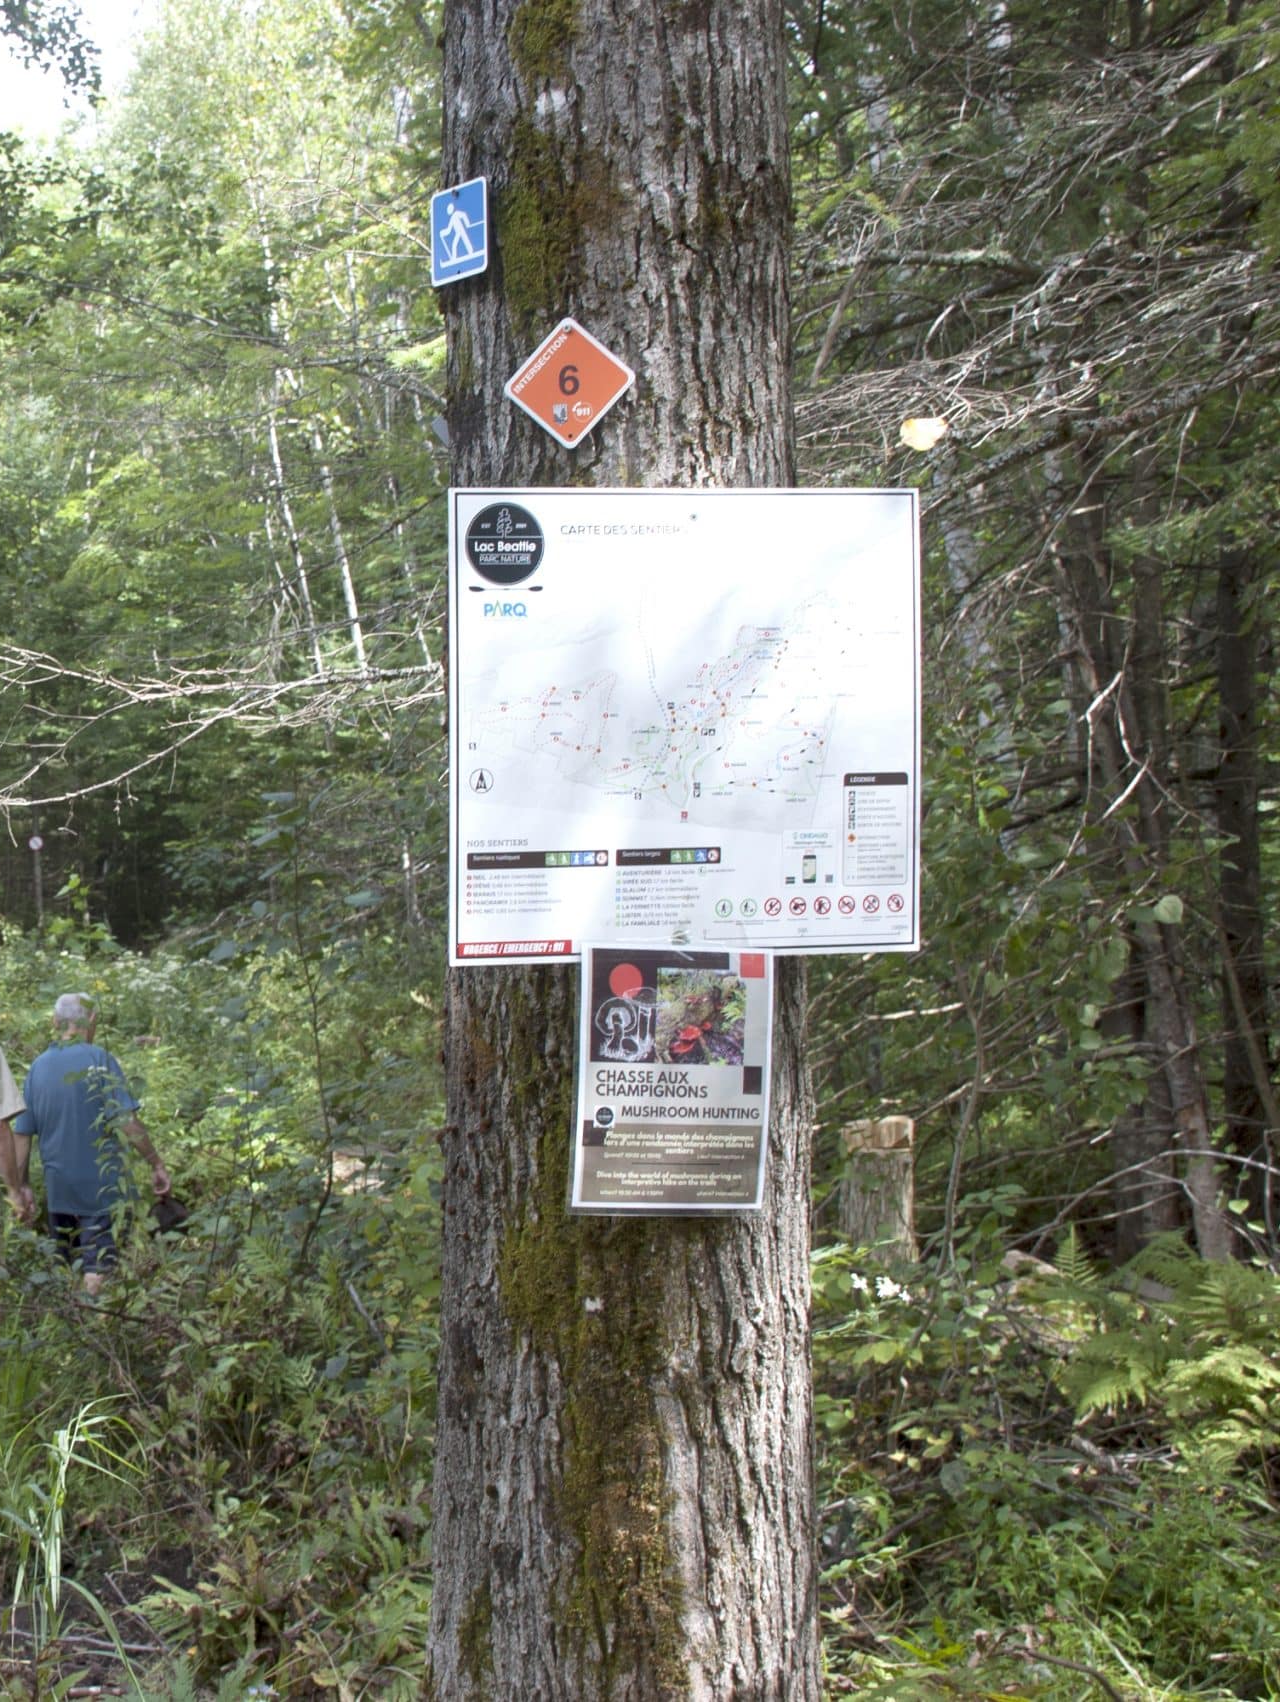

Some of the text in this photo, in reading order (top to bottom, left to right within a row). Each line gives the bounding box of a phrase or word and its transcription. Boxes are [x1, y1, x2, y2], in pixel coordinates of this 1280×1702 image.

[513, 333, 568, 394] INTERSECTION
[558, 364, 580, 396] 6
[575, 407, 591, 417] 911
[560, 525, 601, 535] CARTE
[604, 525, 627, 535] DES
[474, 540, 537, 552] Lac Beattie
[484, 600, 528, 617] PARQ
[467, 838, 529, 848] NOS SENTIERS
[596, 1069, 689, 1084] CHASSE AUX
[595, 1083, 708, 1098] CHAMPIGNONS
[621, 1106, 699, 1118] MUSHROOM
[702, 1107, 760, 1119] HUNTING
[665, 1131, 690, 1140] monde
